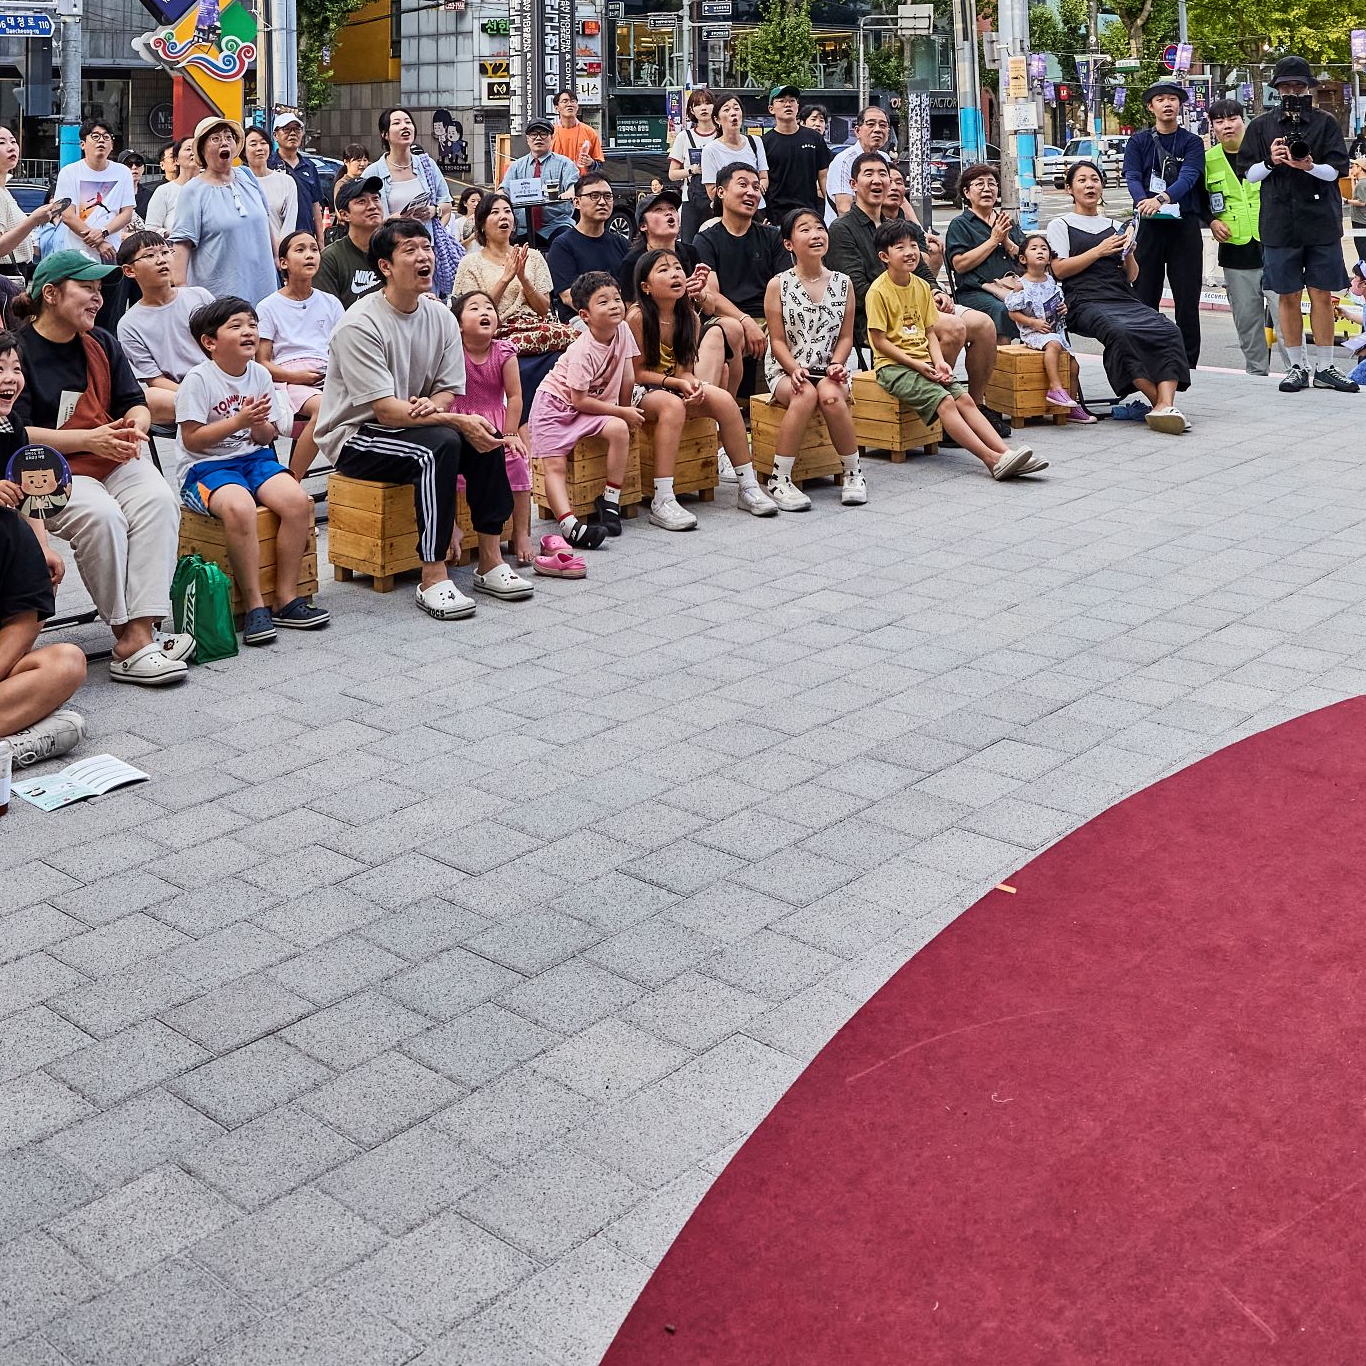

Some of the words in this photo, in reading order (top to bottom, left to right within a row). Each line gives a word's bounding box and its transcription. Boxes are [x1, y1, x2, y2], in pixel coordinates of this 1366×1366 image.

[7, 16, 35, 27] 대청로
[38, 20, 49, 29] 110
[483, 60, 508, 77] Y2
[929, 97, 959, 109] FACTOR
[355, 269, 377, 285] NIKE
[1204, 292, 1228, 300] SECURIT
